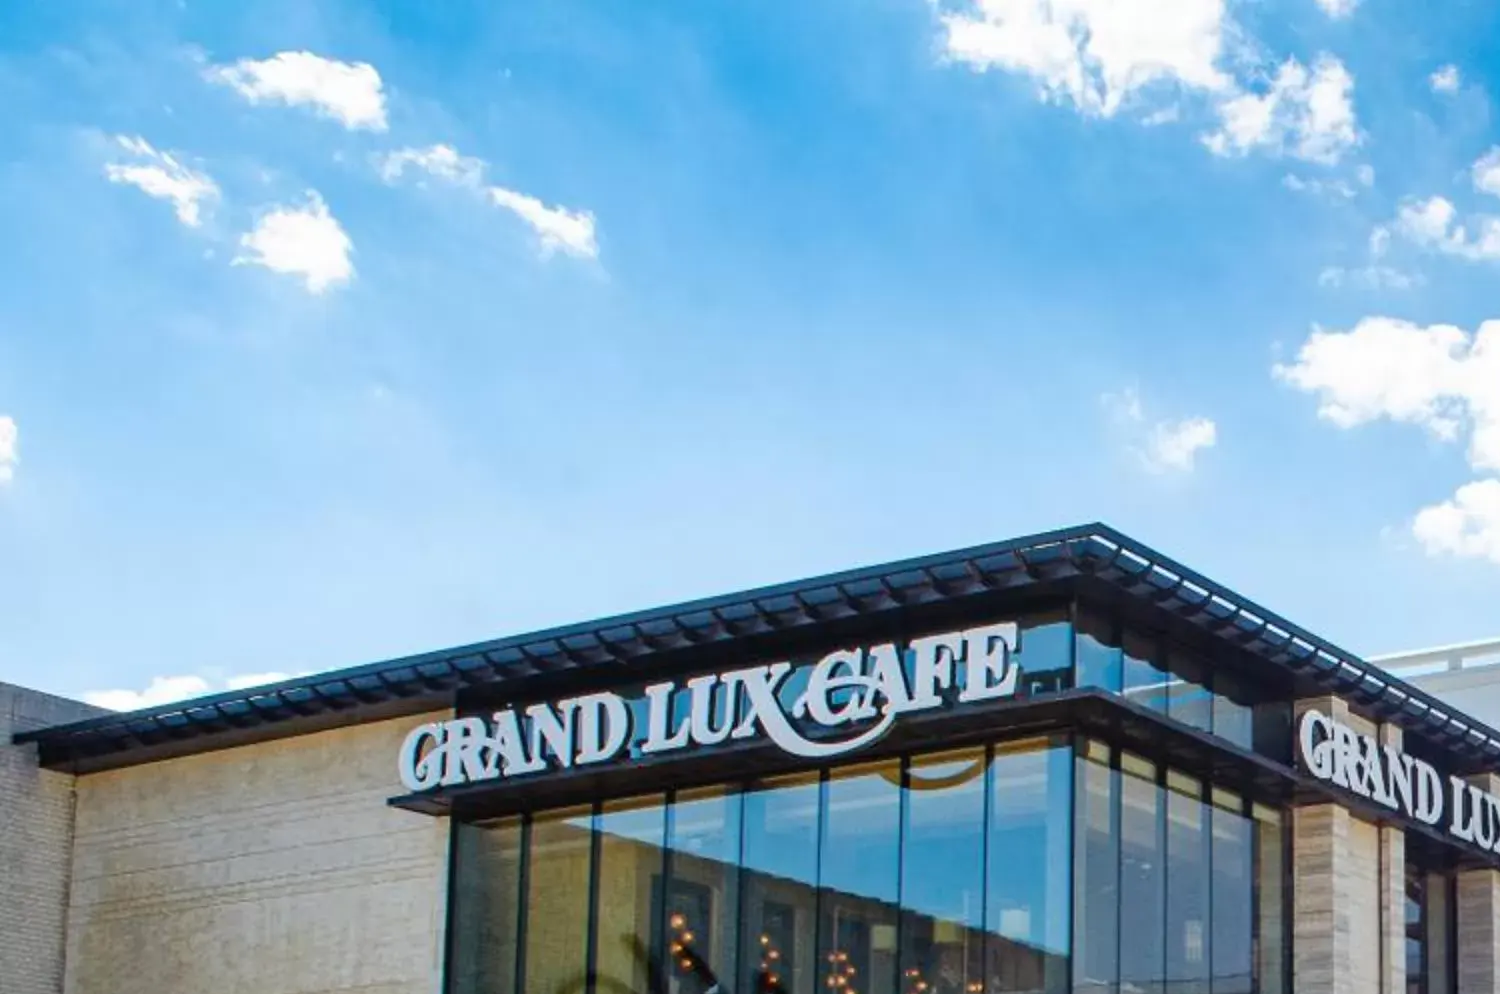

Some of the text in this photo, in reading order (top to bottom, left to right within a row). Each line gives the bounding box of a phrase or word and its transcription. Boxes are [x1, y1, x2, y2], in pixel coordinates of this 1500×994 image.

[397, 621, 1020, 793] GRAND LUX CAFE
[1299, 708, 1443, 826] GRAND
